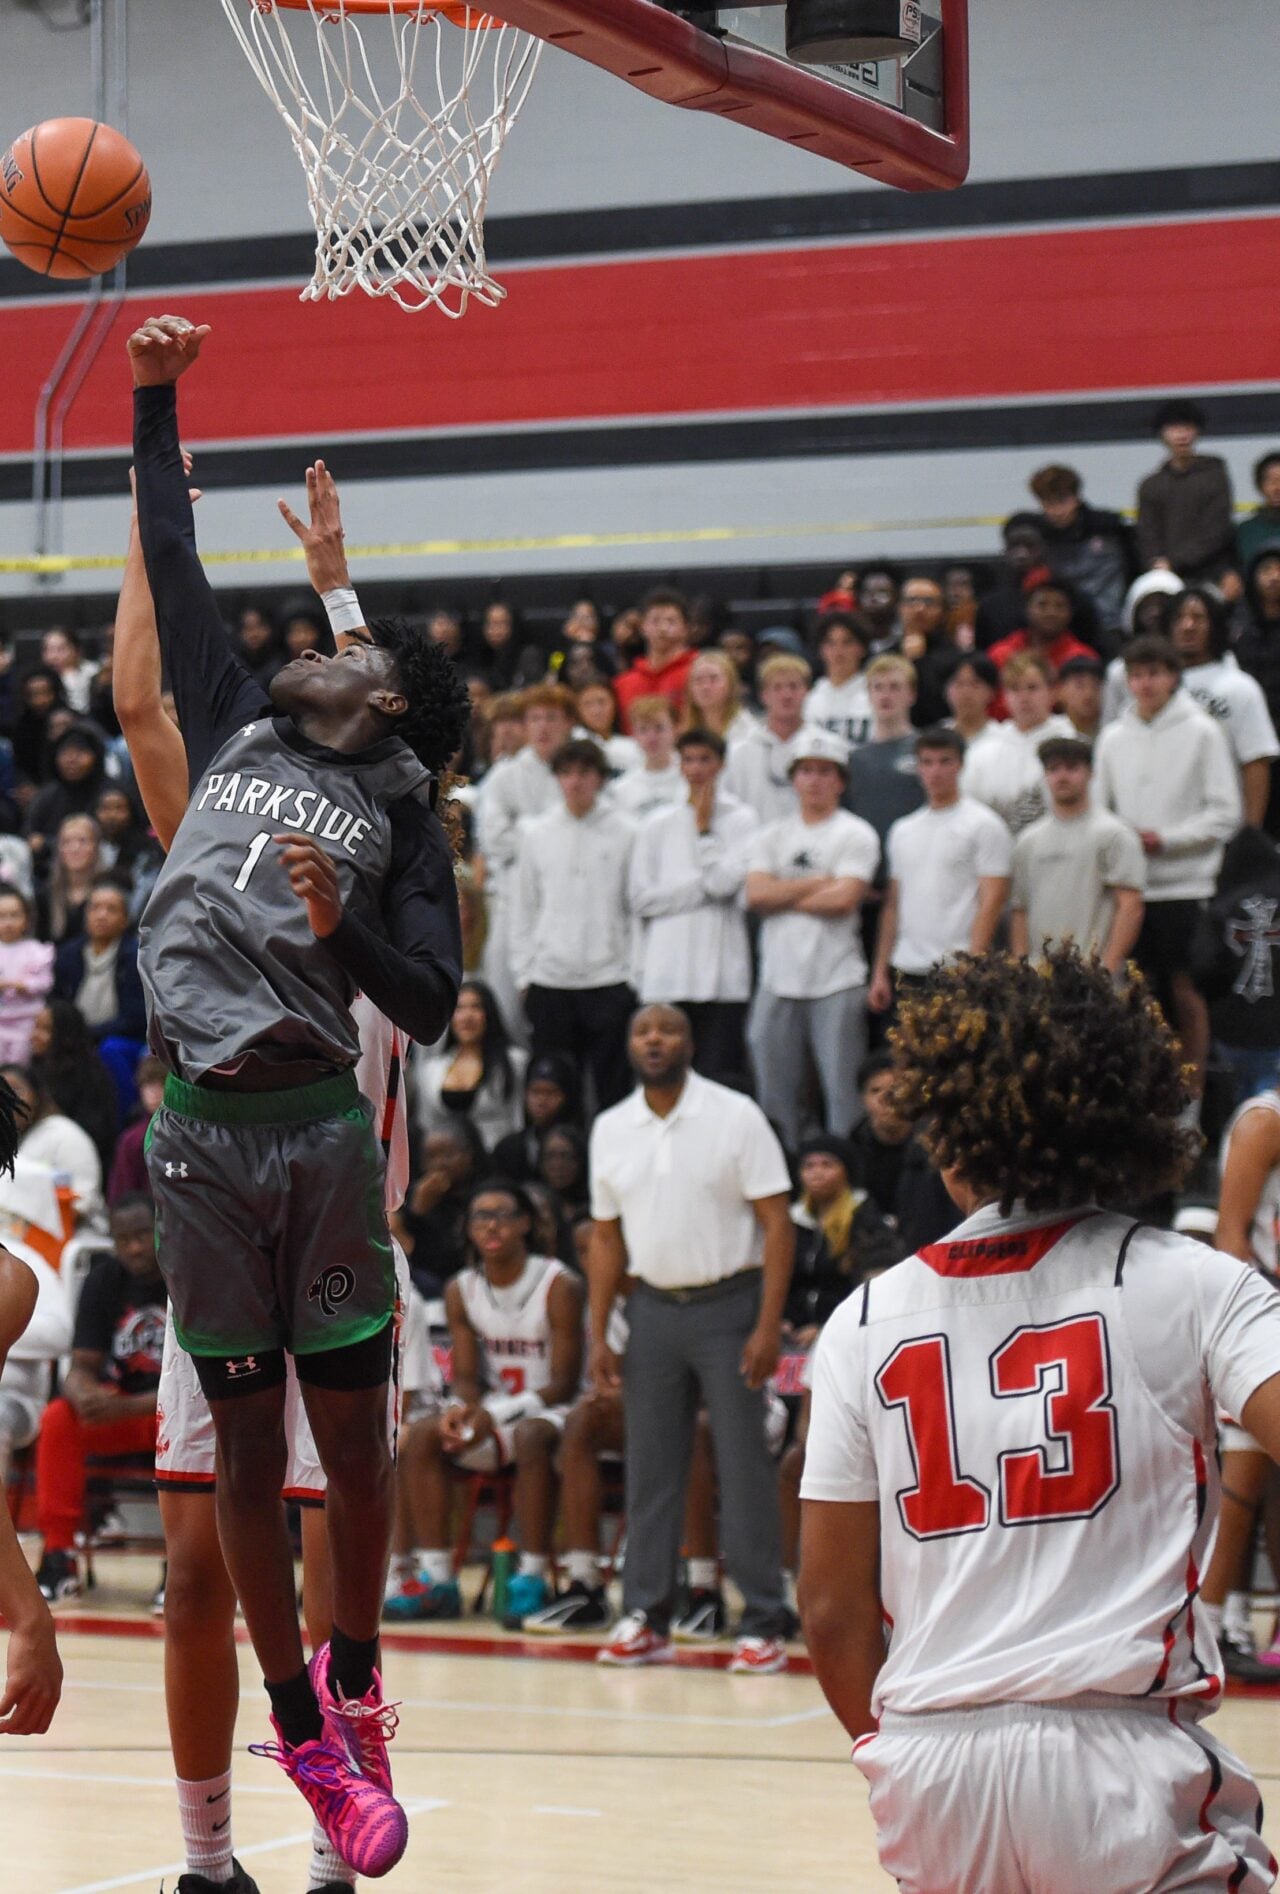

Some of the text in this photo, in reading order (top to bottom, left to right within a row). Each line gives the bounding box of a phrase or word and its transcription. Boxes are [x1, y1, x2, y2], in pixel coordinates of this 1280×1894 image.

[196, 772, 373, 856] PARKSIDE
[232, 830, 272, 893] 1
[874, 1311, 1121, 1543] 13
